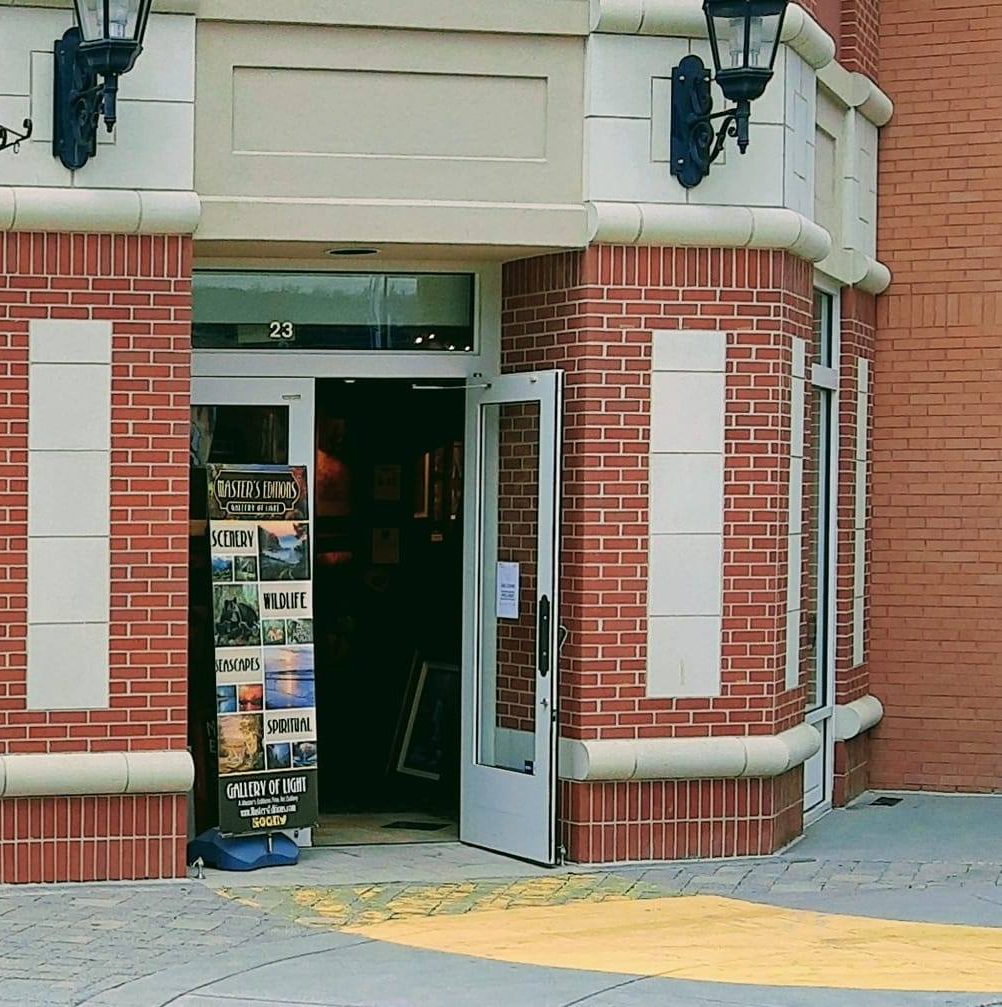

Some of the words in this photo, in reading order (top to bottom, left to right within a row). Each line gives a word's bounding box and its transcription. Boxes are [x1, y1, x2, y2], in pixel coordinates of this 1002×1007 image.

[270, 322, 293, 338] 23
[217, 480, 260, 498] MASTER'S
[262, 481, 297, 499] EDITIONS
[212, 530, 253, 547] SCENERY
[263, 592, 307, 610] WILDLIFE
[215, 657, 260, 673] SEASCAPES
[267, 717, 312, 734] SPIRITUAL
[226, 780, 266, 799] GALLERY
[268, 778, 280, 795] OF
[282, 776, 307, 794] LIGHT
